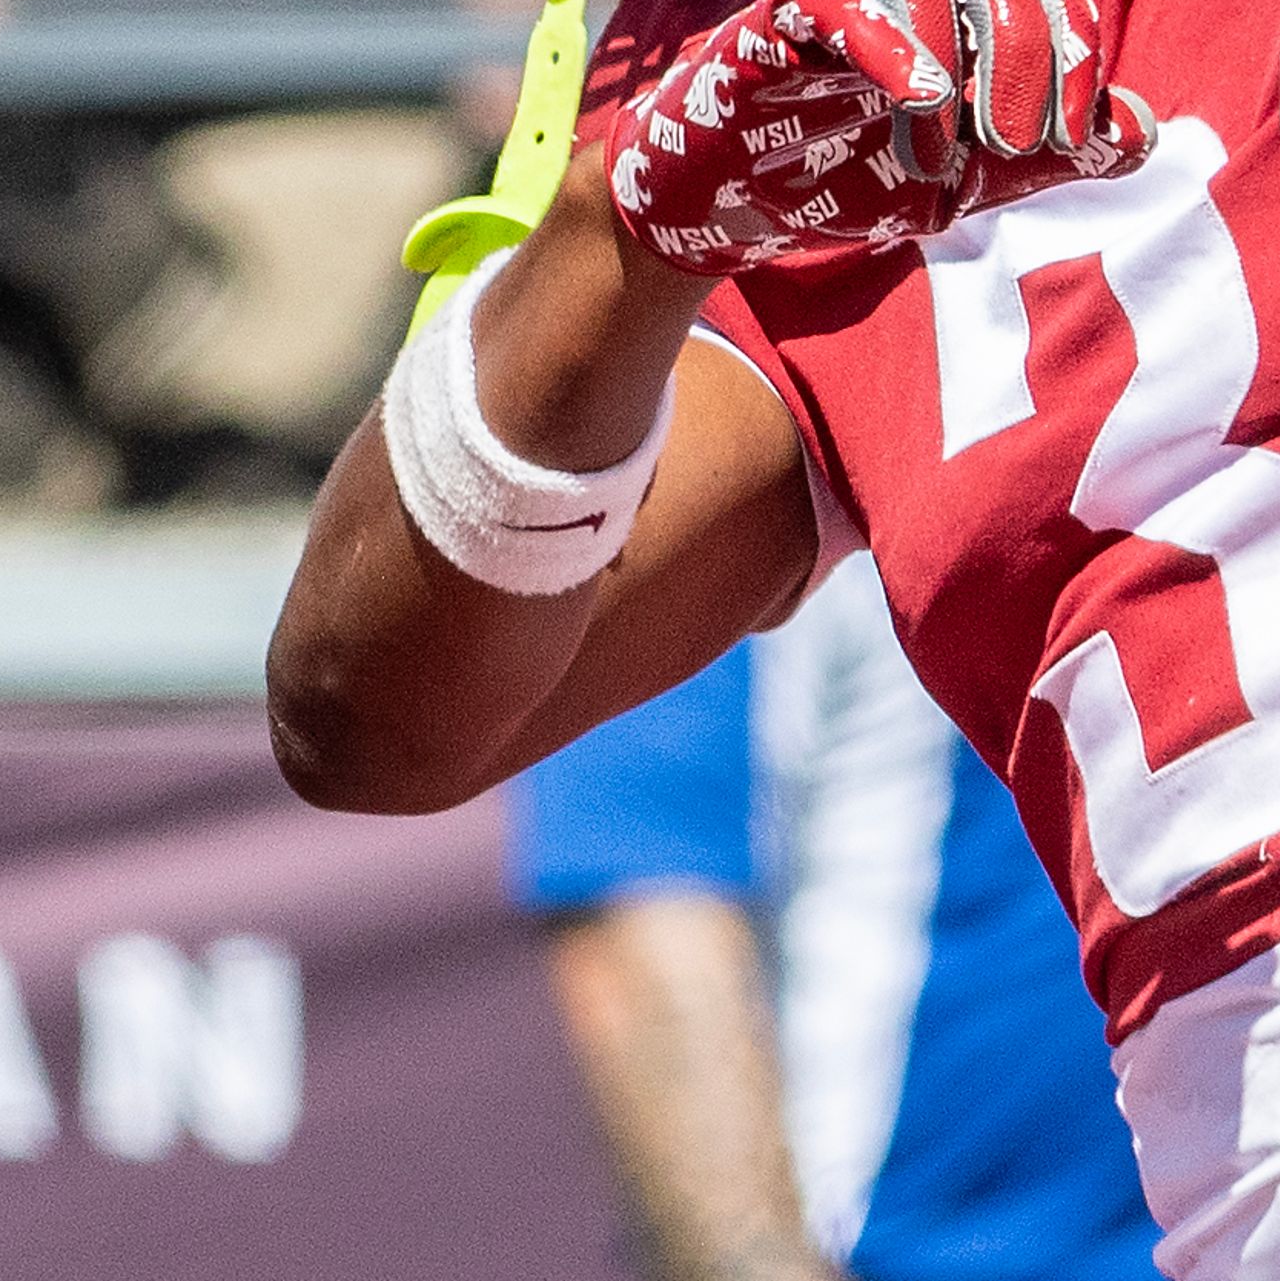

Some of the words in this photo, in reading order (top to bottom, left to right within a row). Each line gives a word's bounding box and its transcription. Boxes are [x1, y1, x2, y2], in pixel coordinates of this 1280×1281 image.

[736, 24, 788, 69] WSU
[647, 109, 687, 157] WSU
[740, 114, 805, 156] WSU
[779, 188, 841, 230] WSU
[648, 222, 733, 256] WSU
